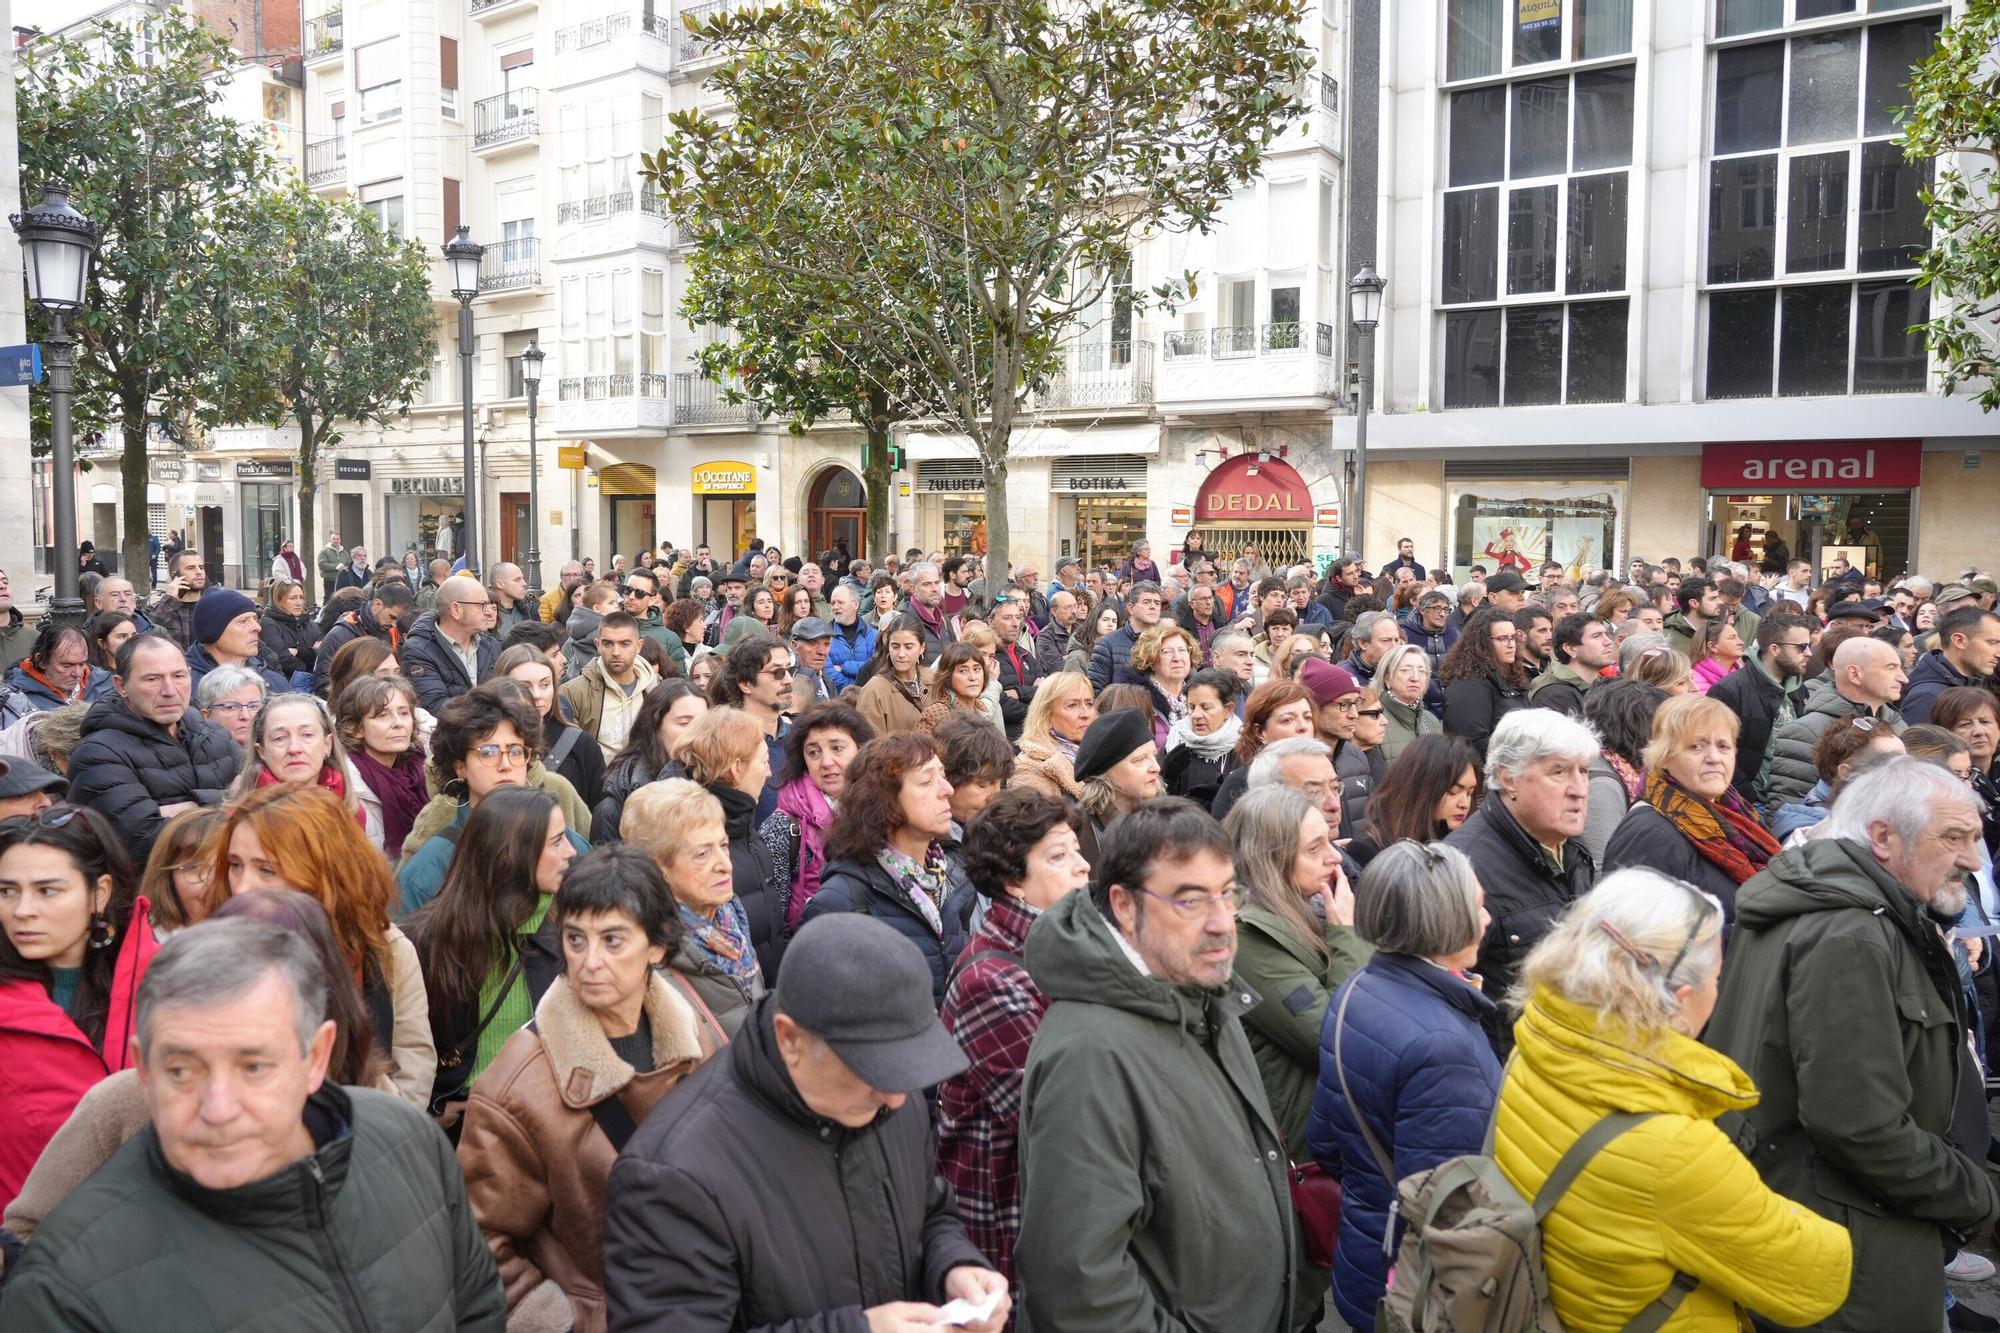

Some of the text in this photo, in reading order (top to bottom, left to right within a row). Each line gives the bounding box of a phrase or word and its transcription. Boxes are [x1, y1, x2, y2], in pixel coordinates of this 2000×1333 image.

[1520, 0, 1557, 13] ALQUILA
[156, 460, 181, 469] HOTEL
[1742, 449, 1875, 479] arenal
[160, 471, 179, 479] DATO
[695, 470, 752, 483] L'OCCITANE
[392, 478, 464, 493] DECIMAS
[928, 479, 985, 490] ZULUETA
[1070, 478, 1127, 490] BOTIKA
[1207, 493, 1303, 512] DEDAL
